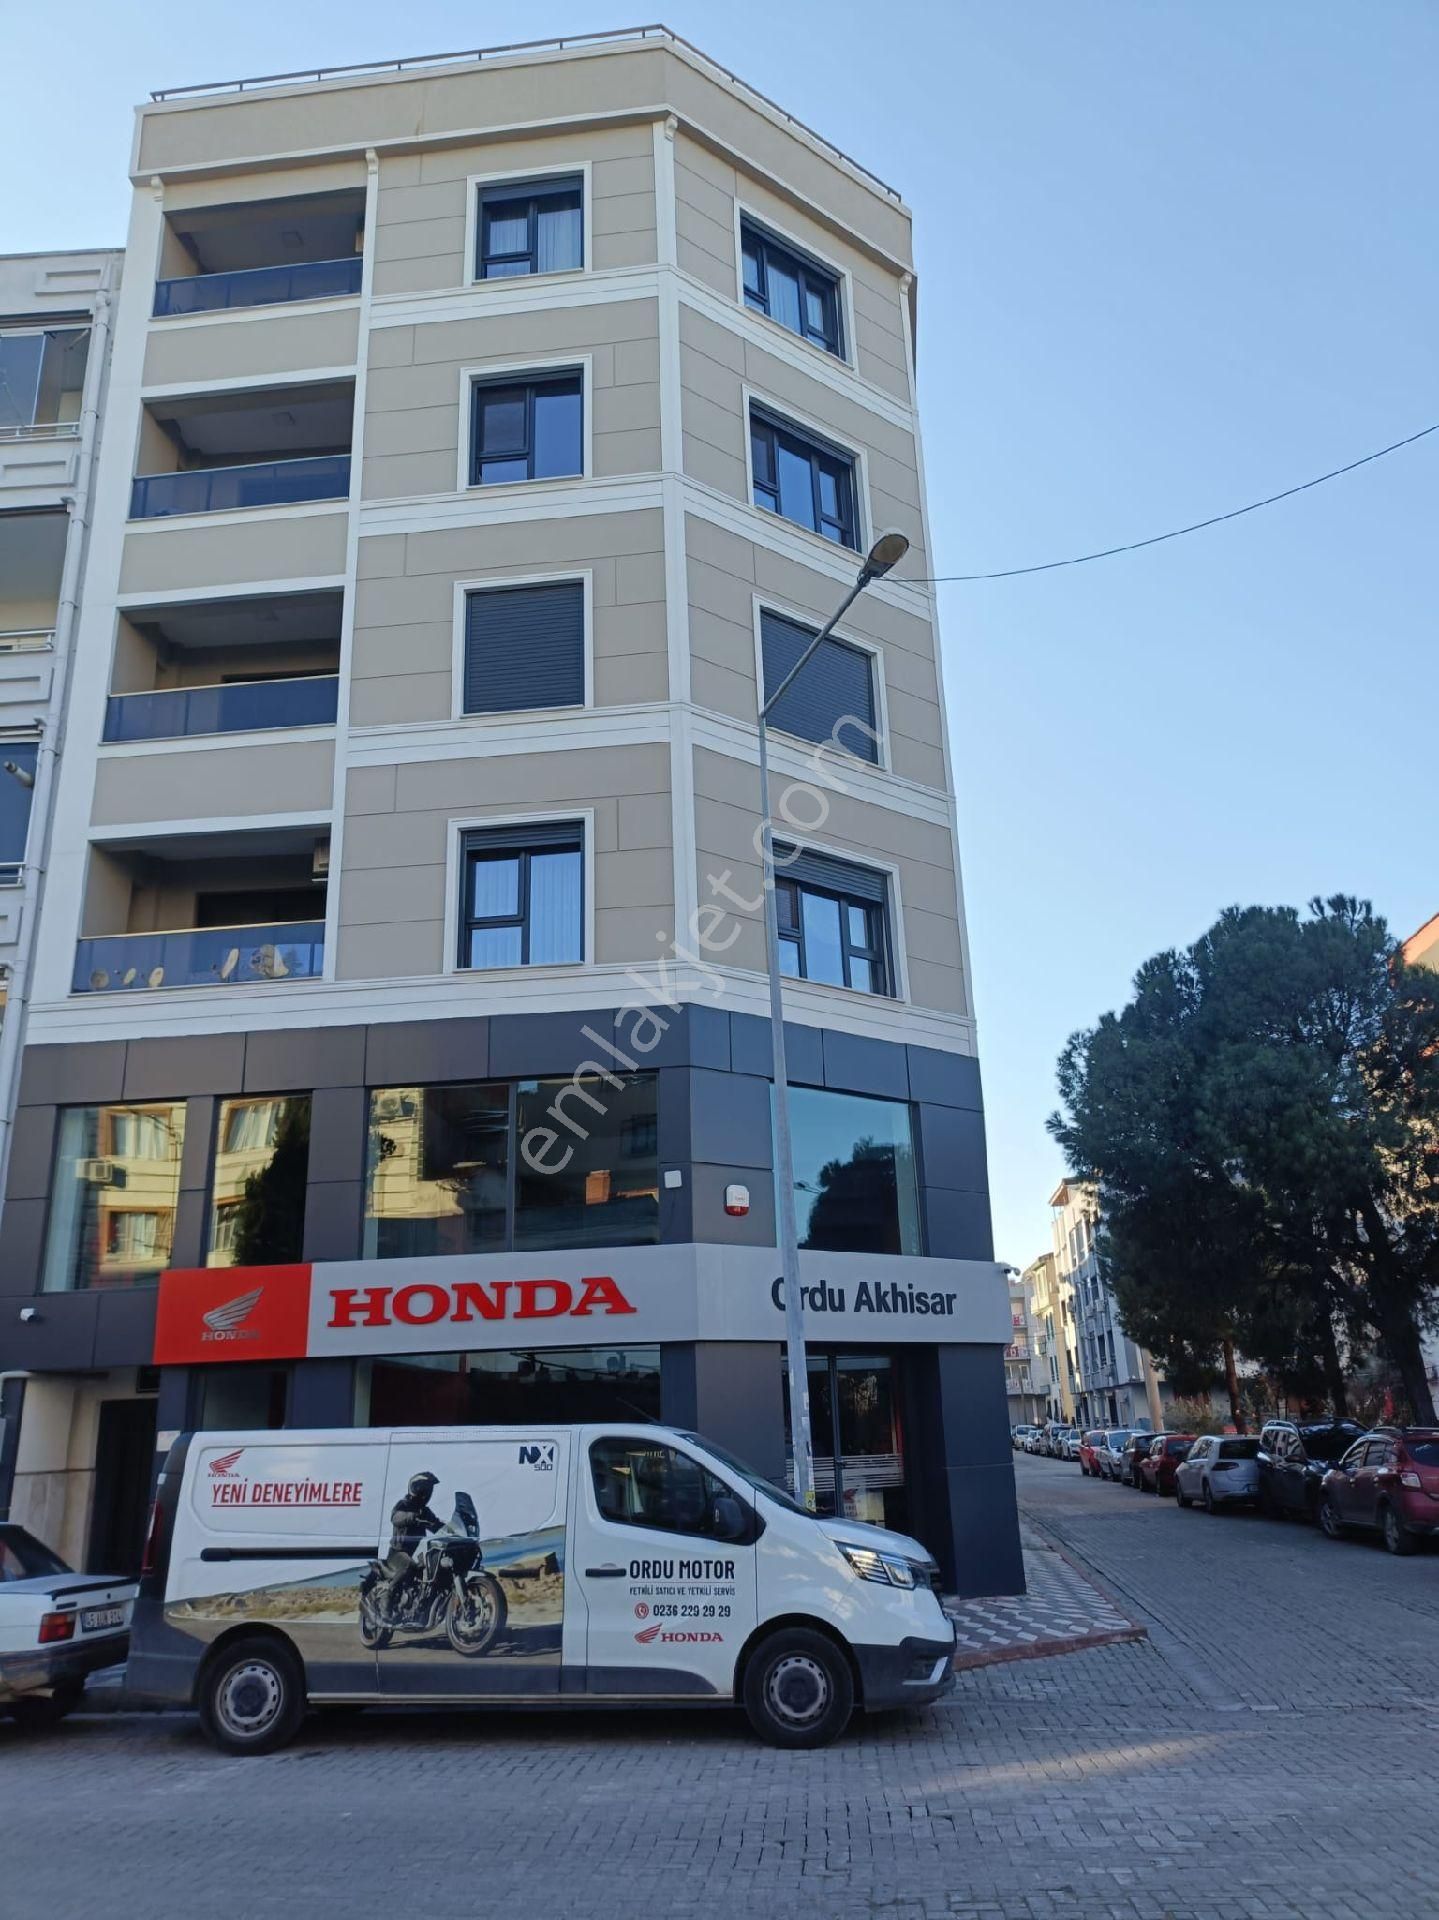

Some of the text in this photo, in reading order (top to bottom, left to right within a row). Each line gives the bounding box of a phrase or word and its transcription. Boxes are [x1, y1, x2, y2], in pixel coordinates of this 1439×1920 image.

[327, 1277, 637, 1328] HONDA
[854, 1281, 957, 1315] Akhisar
[519, 1446, 554, 1464] NX
[212, 1477, 363, 1503] YENİ DENEYİMLERE
[630, 1560, 735, 1579] ORDU MOTOR
[677, 1586, 685, 1595] VE
[653, 1604, 731, 1617] 0236 229 29 29
[661, 1632, 723, 1643] HONDA
